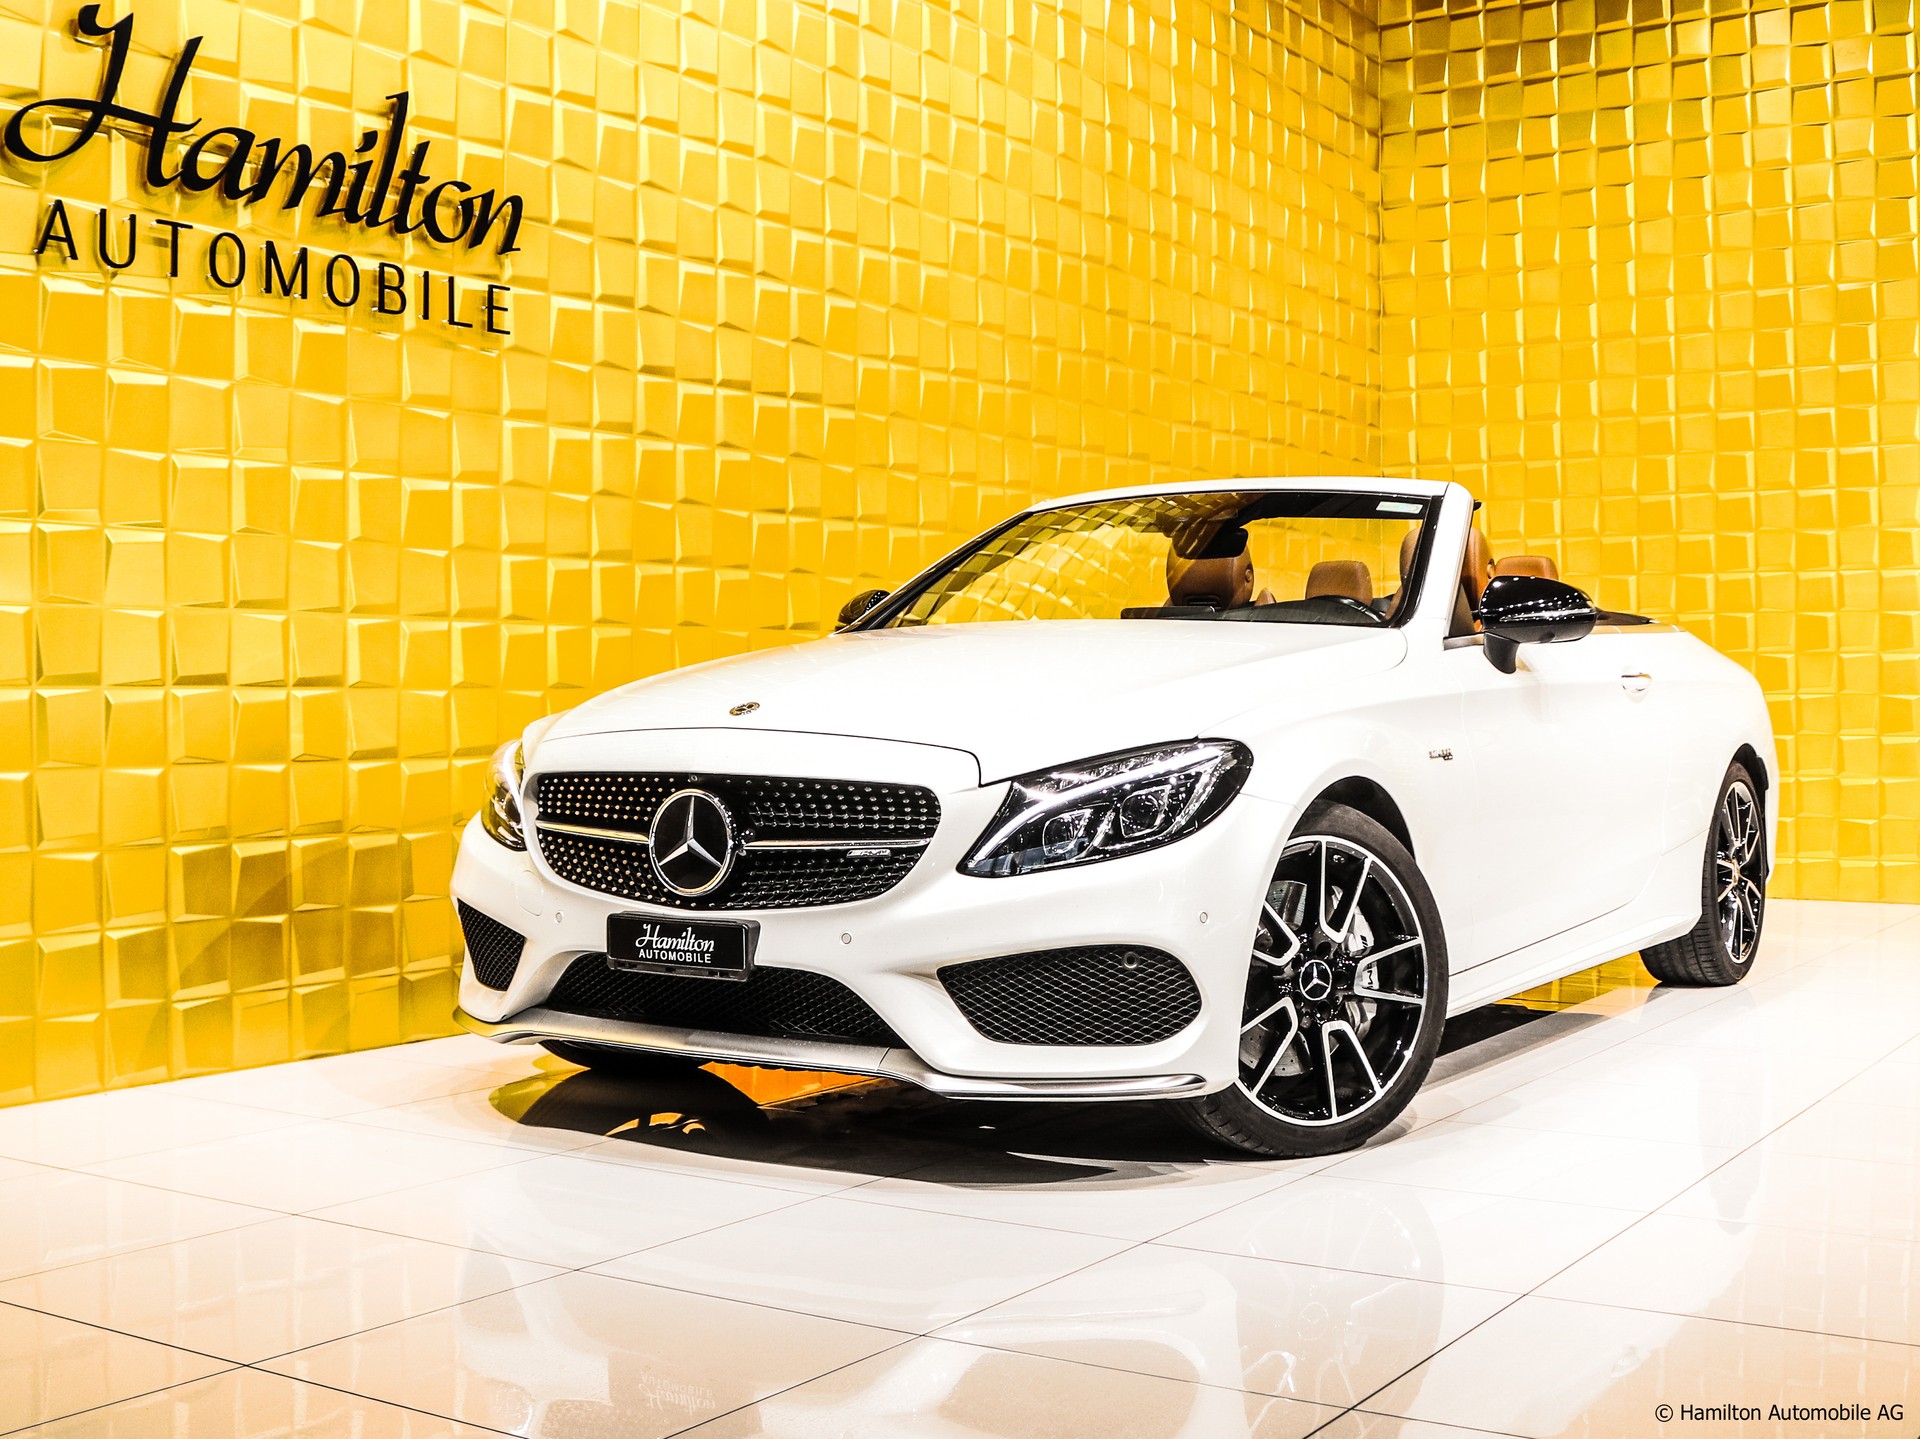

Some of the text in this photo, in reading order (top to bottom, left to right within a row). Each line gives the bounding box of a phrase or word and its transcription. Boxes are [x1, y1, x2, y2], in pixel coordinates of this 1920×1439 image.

[3, 3, 524, 255] Hamilton
[34, 199, 512, 336] AUTOMOBILE
[635, 923, 715, 952] Hamilton
[638, 948, 712, 964] AUTOMOBILE
